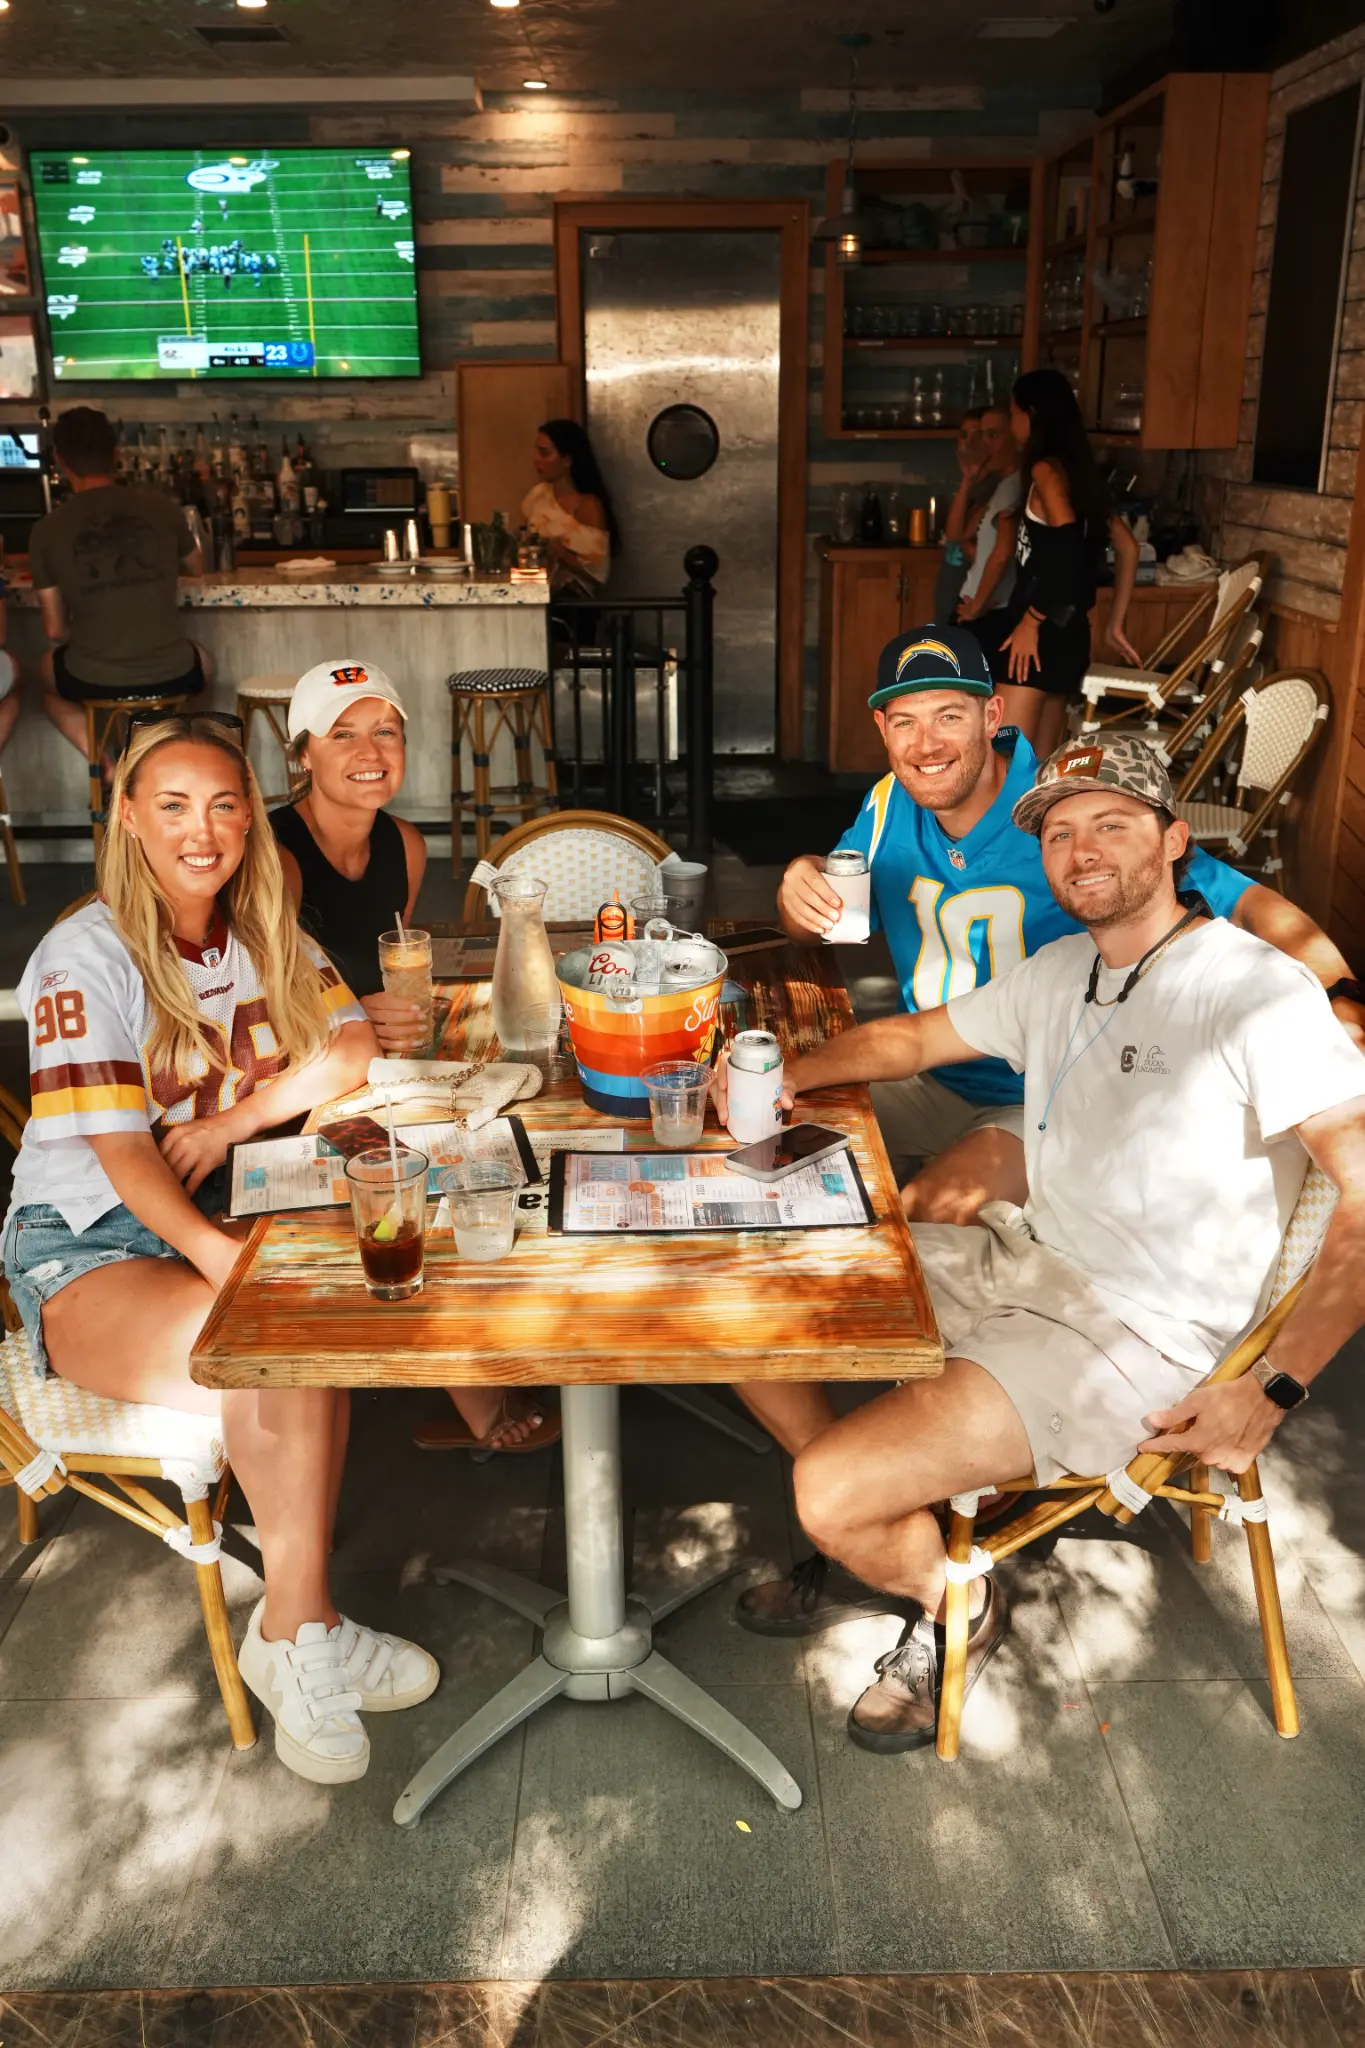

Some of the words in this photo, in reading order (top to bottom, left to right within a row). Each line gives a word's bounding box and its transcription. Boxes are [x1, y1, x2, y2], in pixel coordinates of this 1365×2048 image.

[265, 345, 288, 361] 23
[1063, 756, 1091, 773] JPH
[908, 876, 1027, 1007] 10
[33, 989, 88, 1047] 98
